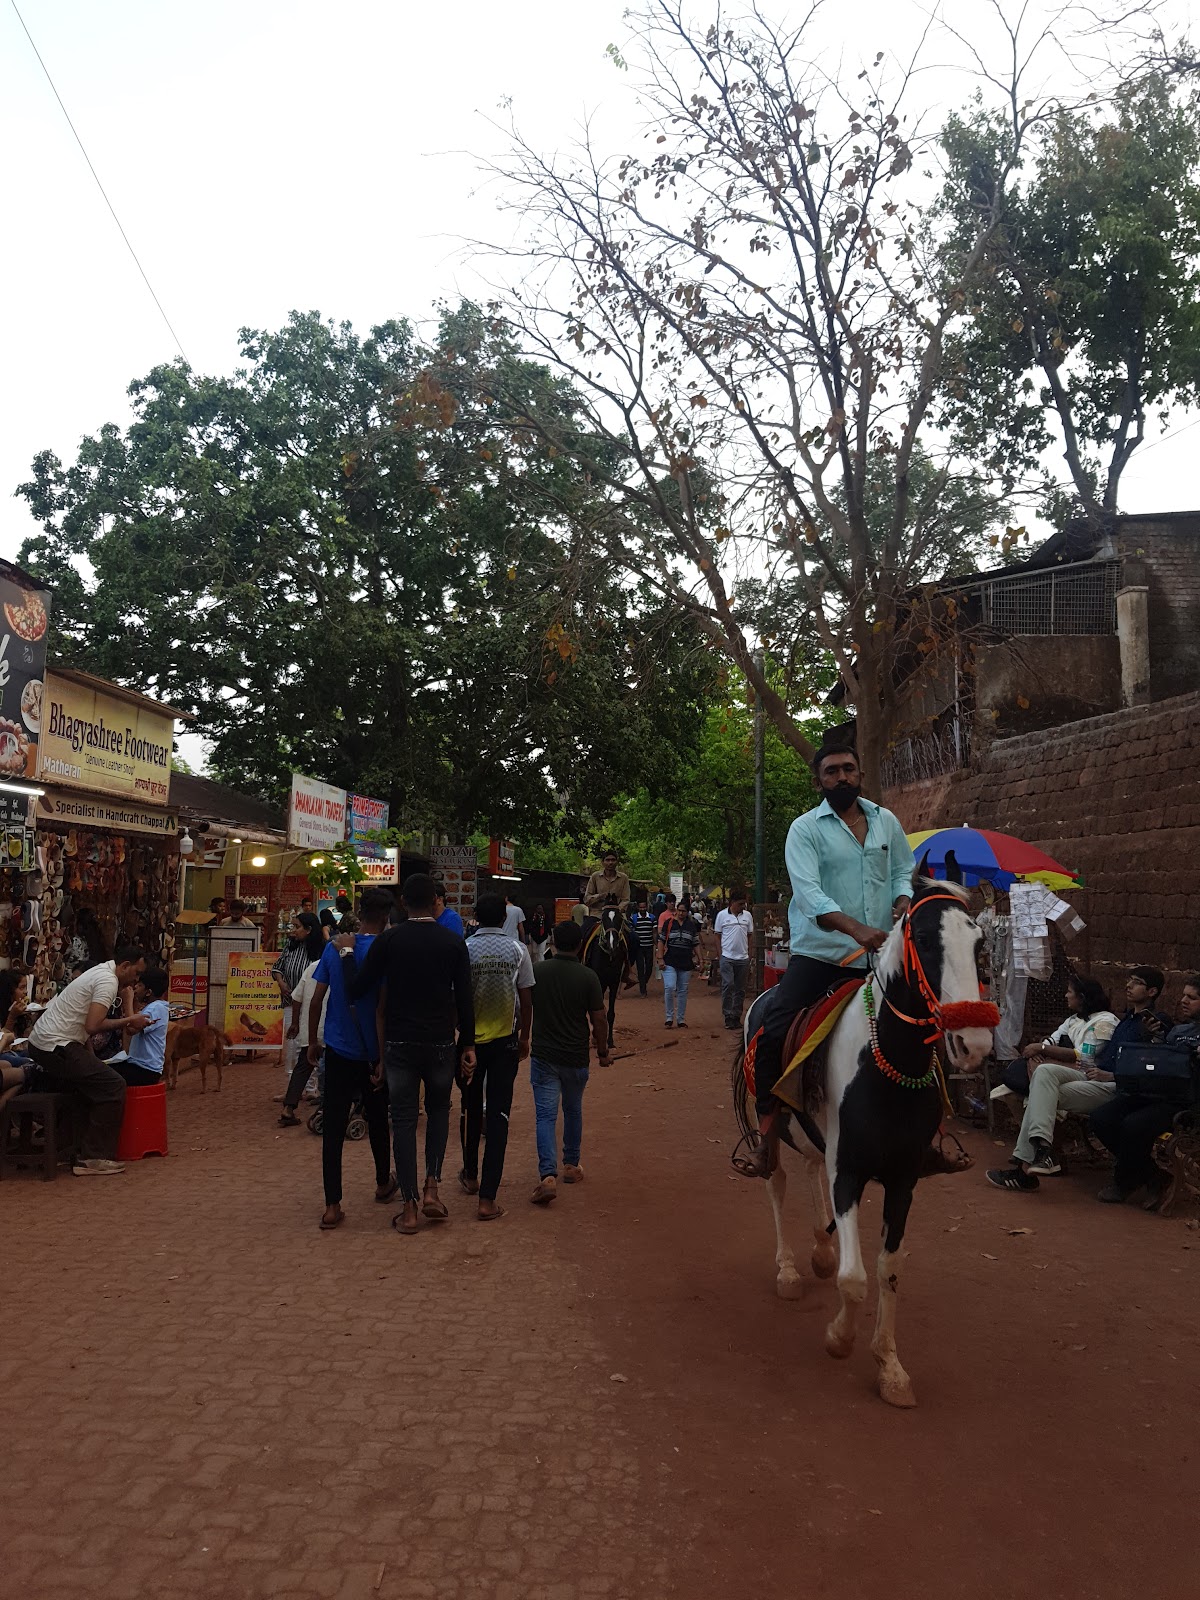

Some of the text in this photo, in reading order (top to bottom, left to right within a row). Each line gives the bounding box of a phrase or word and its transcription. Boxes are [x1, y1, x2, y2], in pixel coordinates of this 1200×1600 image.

[48, 701, 169, 768] Bhagyashree Footwear
[43, 755, 82, 779] Matheran
[56, 800, 165, 828] Specialist in Handcraft Chappal
[325, 799, 345, 823] TRADERS
[299, 817, 312, 830] General
[431, 846, 476, 857] ROYAL
[231, 968, 272, 979] Bhagyash
[240, 980, 274, 988] Foot Wear
